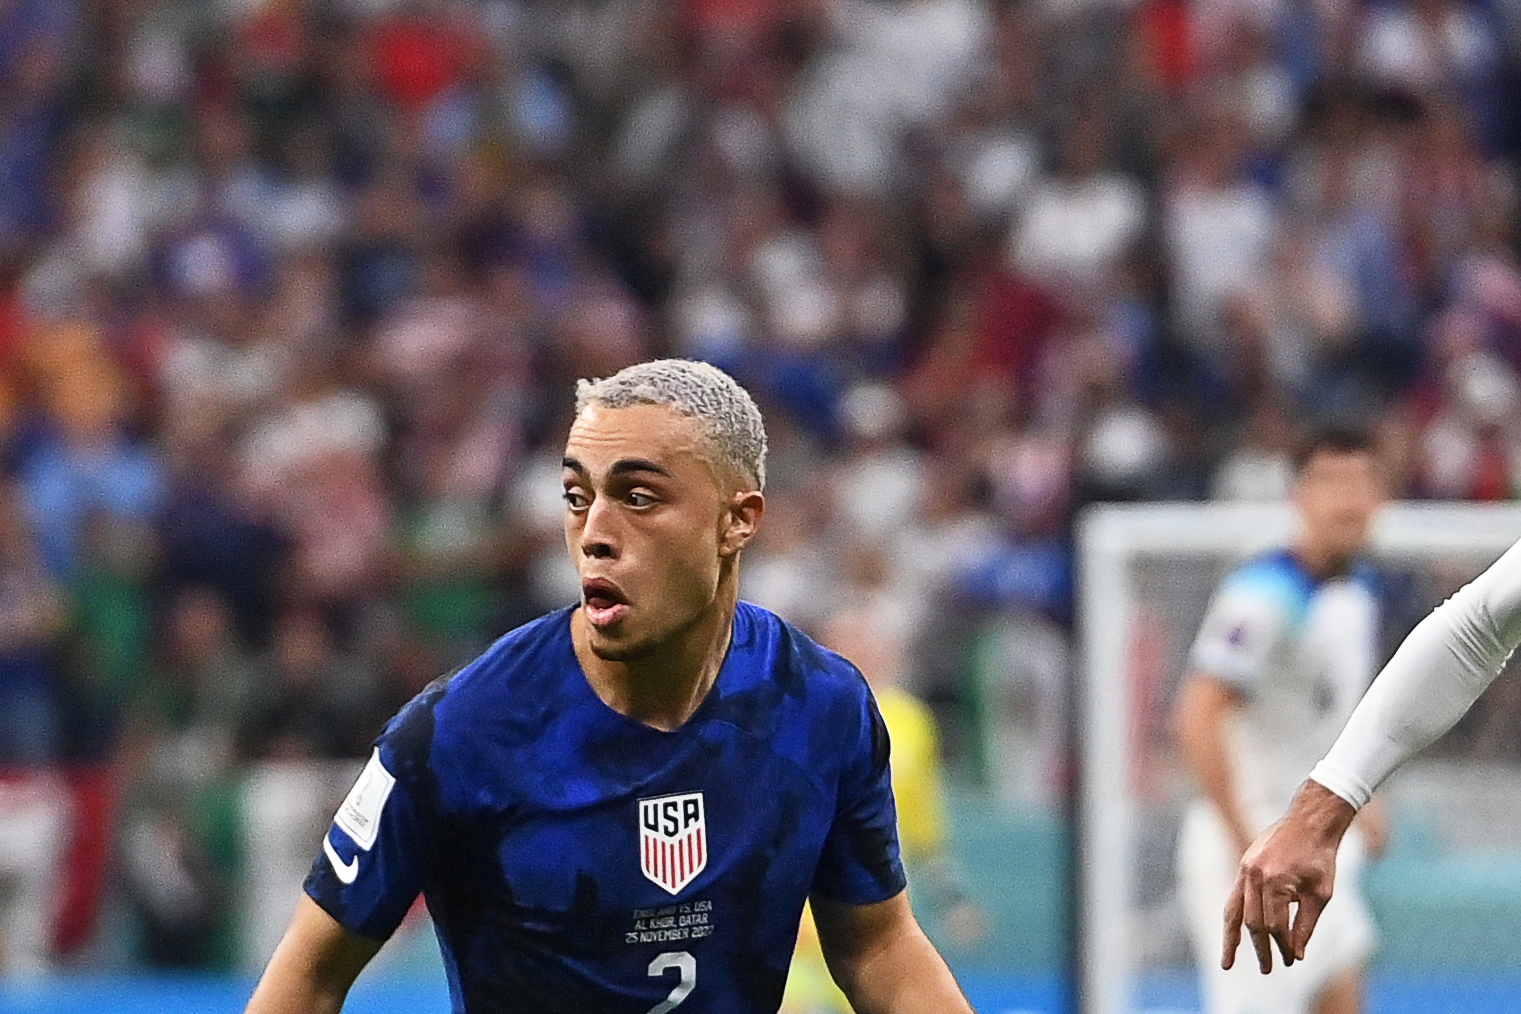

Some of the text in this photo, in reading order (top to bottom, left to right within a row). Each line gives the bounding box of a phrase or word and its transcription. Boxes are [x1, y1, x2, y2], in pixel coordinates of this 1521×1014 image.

[643, 798, 700, 838] USA
[693, 900, 713, 913] USA
[635, 919, 647, 930] AL
[678, 913, 709, 927] QATAR
[625, 931, 639, 944] 25
[640, 928, 689, 943] NOVEMBER
